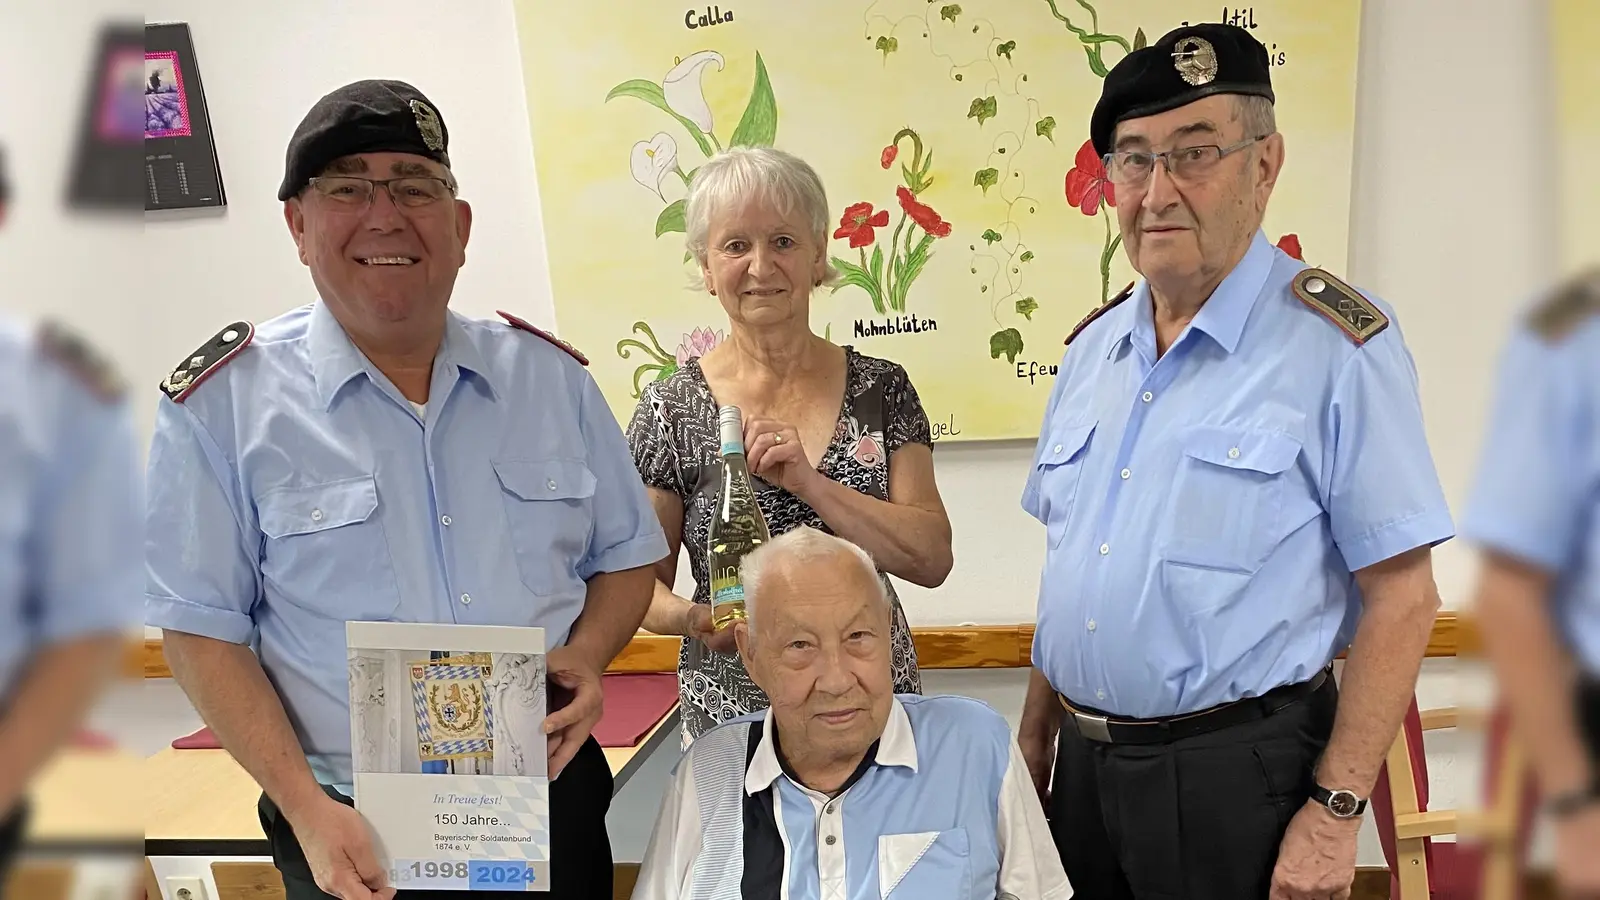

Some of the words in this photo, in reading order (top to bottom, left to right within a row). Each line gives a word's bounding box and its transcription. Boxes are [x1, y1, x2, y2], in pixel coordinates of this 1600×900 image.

[684, 5, 734, 29] Calla
[854, 313, 938, 338] Mohnblüten
[1017, 361, 1058, 385] Efeu
[433, 794, 444, 804] In
[448, 794, 478, 805] Treue
[478, 794, 503, 808] fest!
[434, 813, 458, 825] 150
[462, 814, 511, 826] Jahre...
[434, 834, 479, 842] Bayerischer
[480, 834, 532, 842] Soldatenbund
[410, 861, 469, 878] 1998
[477, 866, 536, 884] 2024
